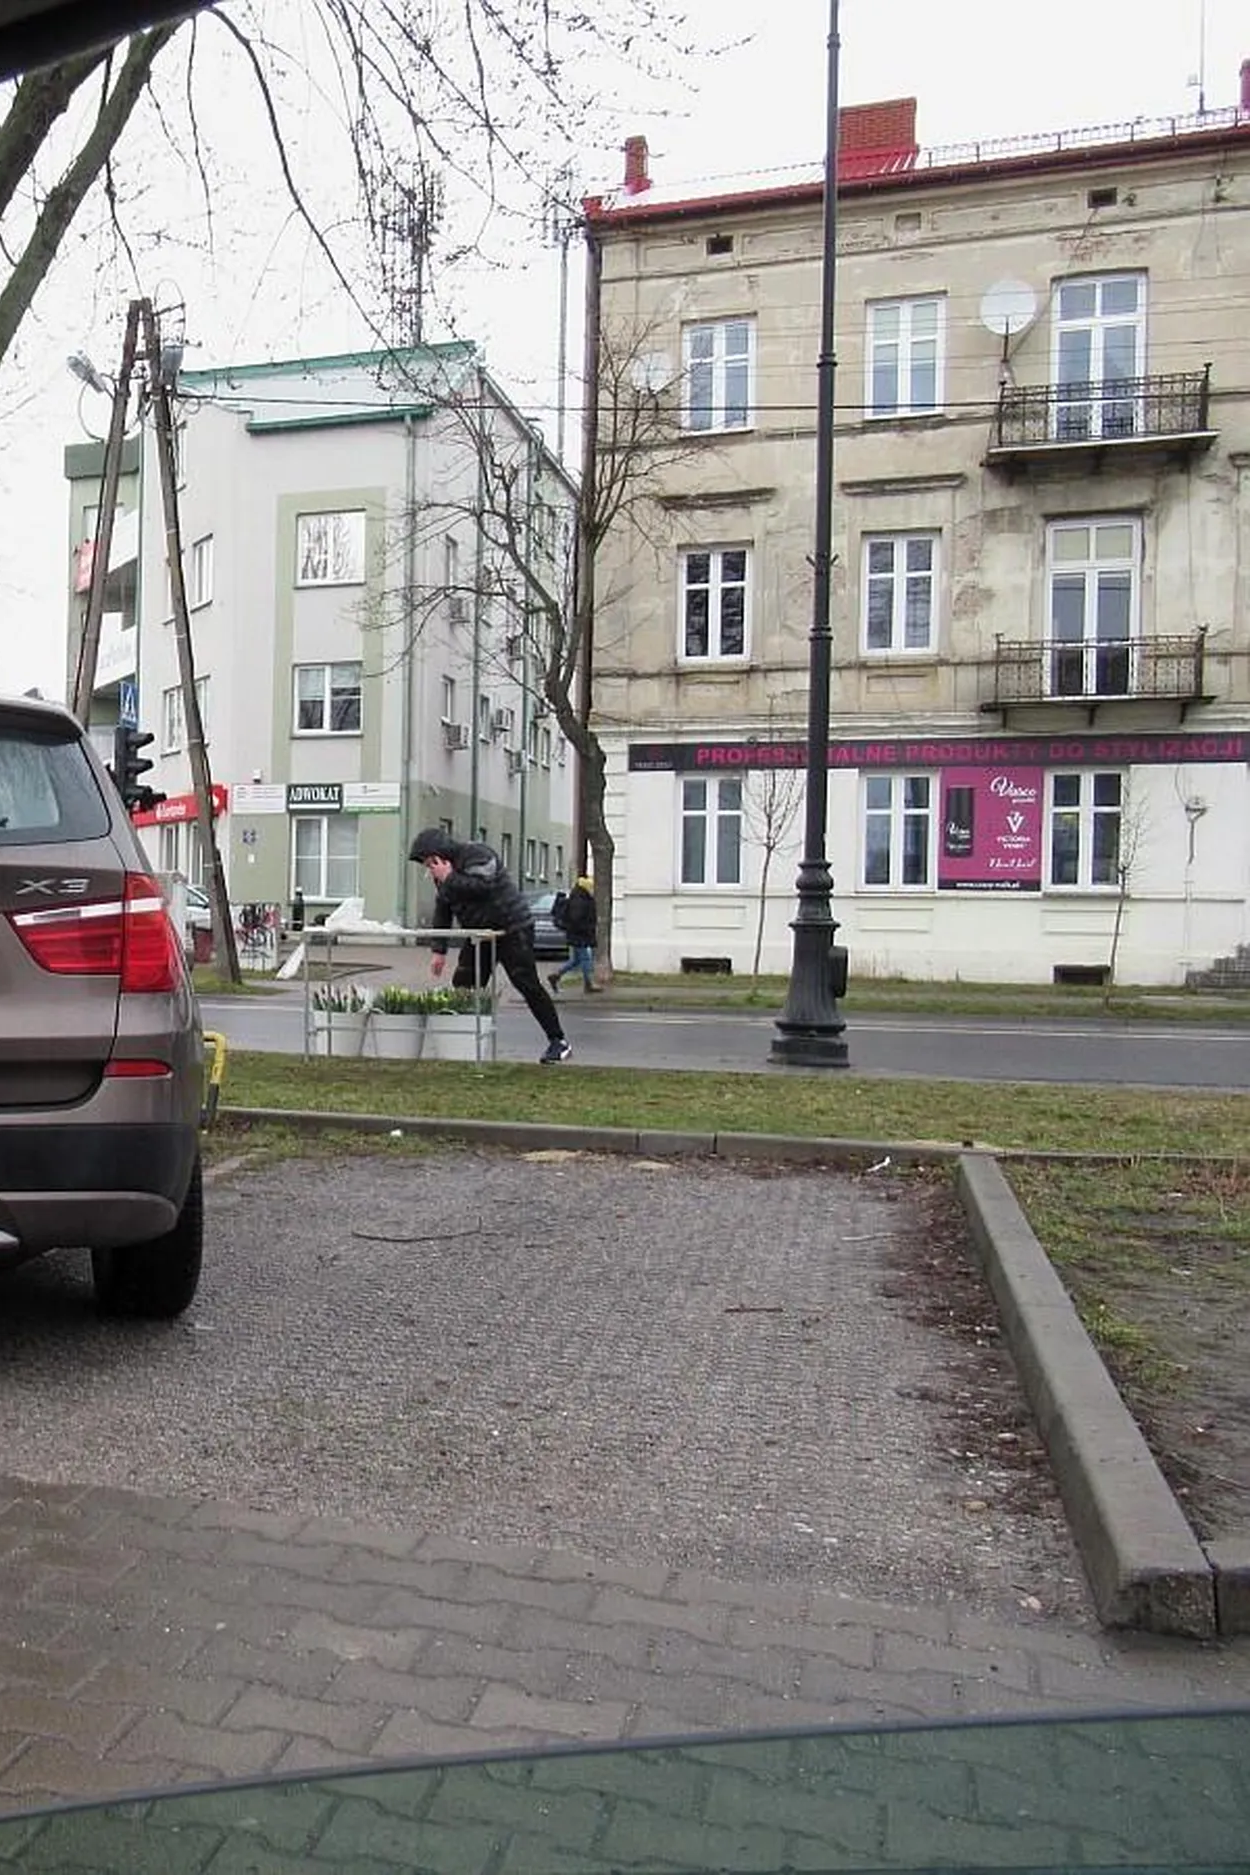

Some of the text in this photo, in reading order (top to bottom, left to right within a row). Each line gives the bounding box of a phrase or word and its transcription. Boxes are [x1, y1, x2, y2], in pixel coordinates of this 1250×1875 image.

[697, 745, 897, 766] PROFESJALNE
[289, 786, 340, 801] ADWOKAT
[15, 878, 91, 895] X3
